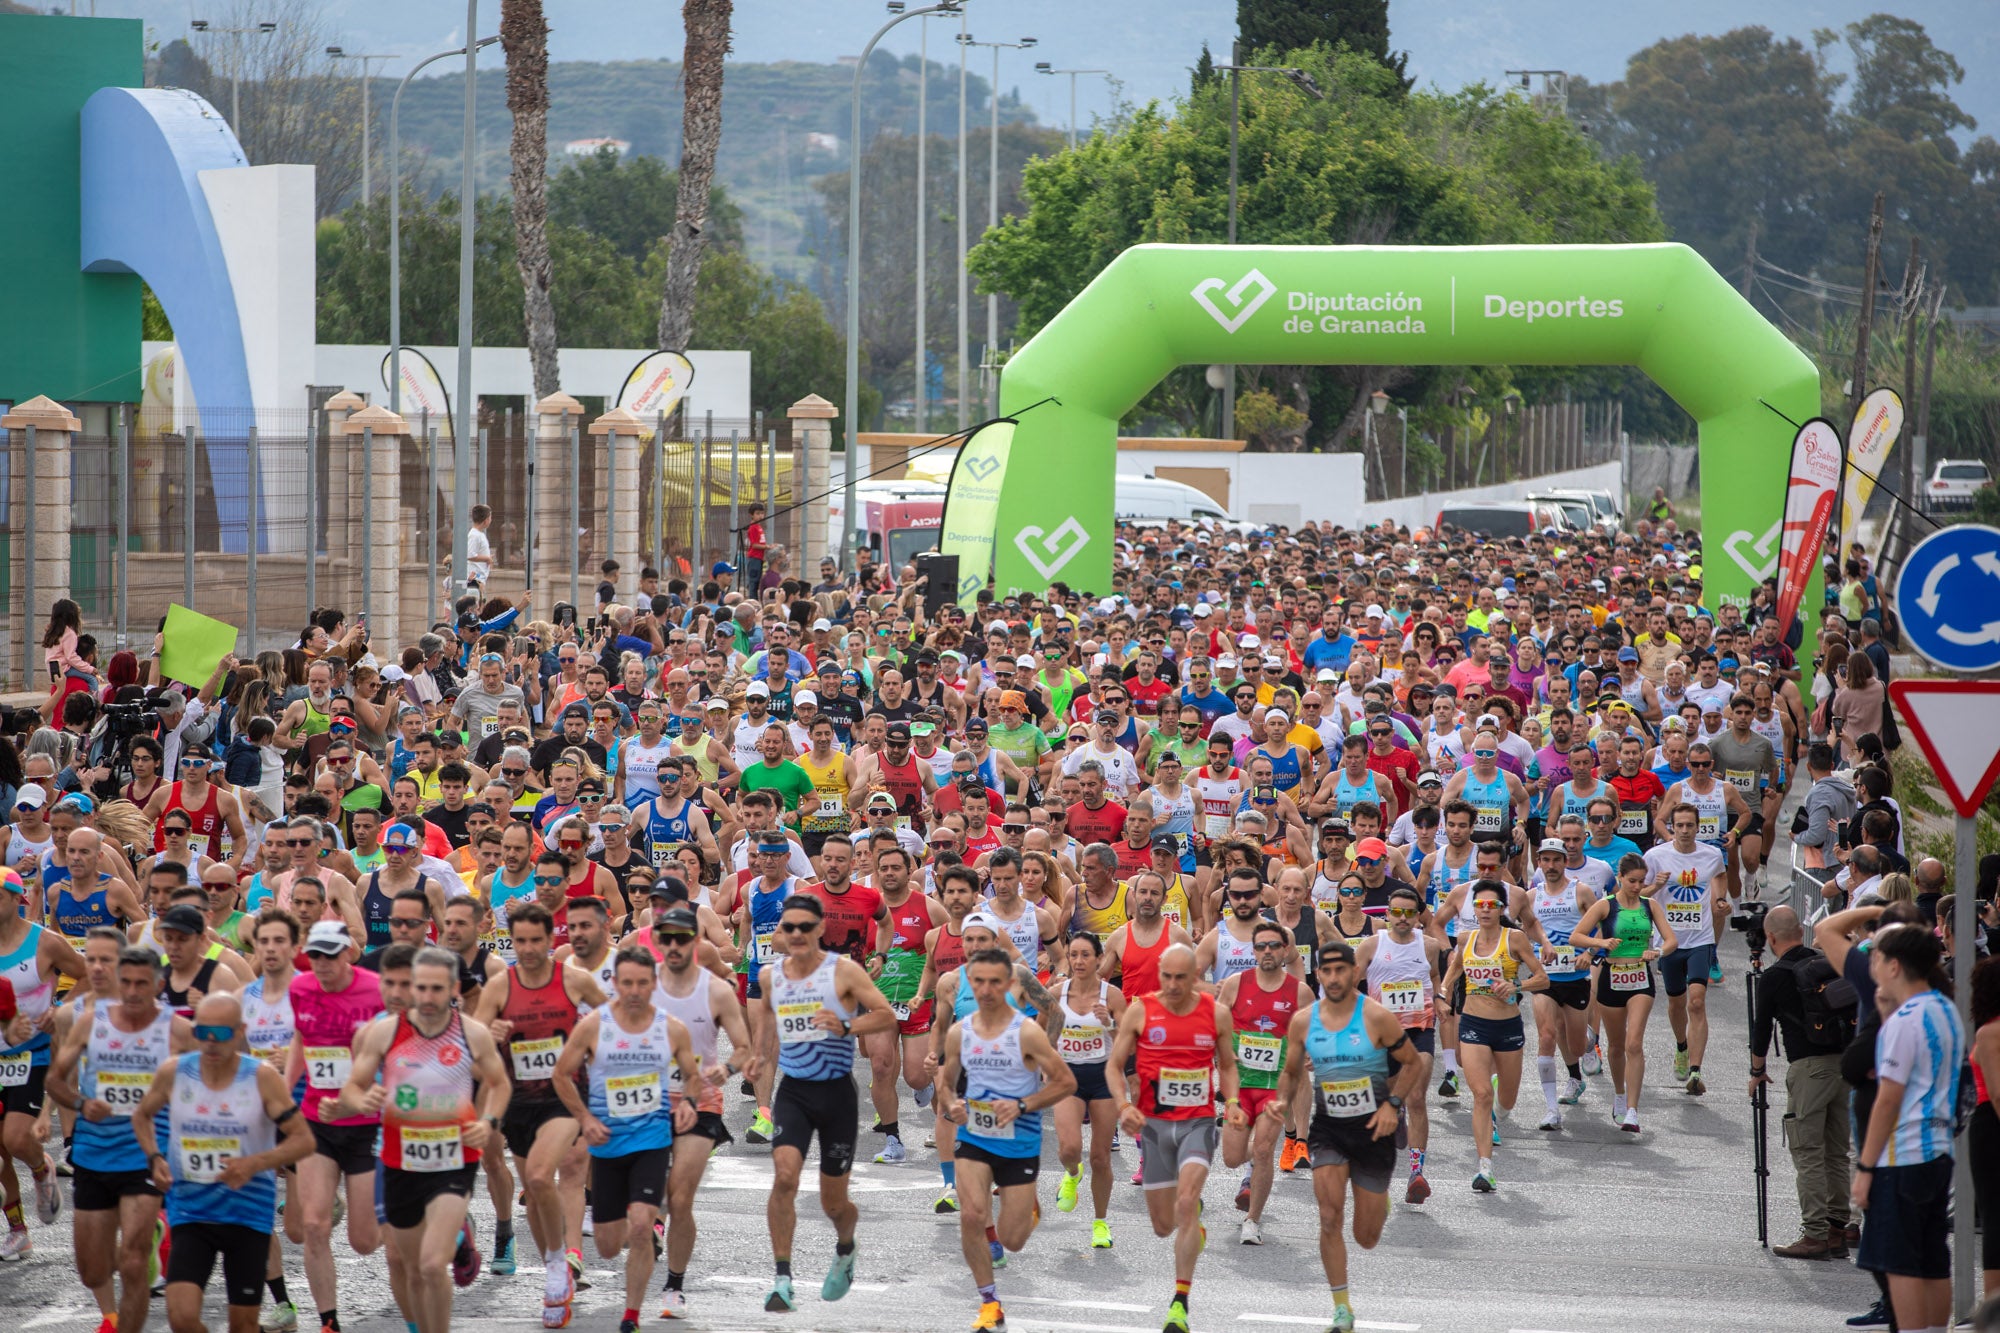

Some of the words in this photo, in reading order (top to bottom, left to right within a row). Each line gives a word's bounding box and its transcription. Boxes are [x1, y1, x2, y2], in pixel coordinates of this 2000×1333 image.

[1287, 290, 1422, 316] Diputación
[1484, 294, 1624, 323] Deportes
[1283, 315, 1313, 333] de
[1319, 315, 1426, 334] Granada
[1858, 406, 1888, 454] Cruzcampo
[947, 532, 993, 543] Deportes
[1729, 778, 1750, 786] 546
[1621, 819, 1643, 828] 296
[1668, 911, 1700, 923] 3245
[1465, 968, 1502, 980] 2026
[1612, 972, 1647, 984] 2008
[1388, 991, 1418, 1005] 117
[1062, 1038, 1103, 1052] 2069
[521, 1052, 556, 1070] 140
[606, 1052, 663, 1063] MARACENA
[967, 1057, 1013, 1067] MARACENA
[1244, 1047, 1274, 1062] 872
[314, 1061, 335, 1078] 21
[105, 1086, 145, 1104] 639
[615, 1087, 654, 1106] 913
[1167, 1081, 1203, 1097] 555
[1327, 1089, 1371, 1107] 4031
[404, 1140, 459, 1160] 4017
